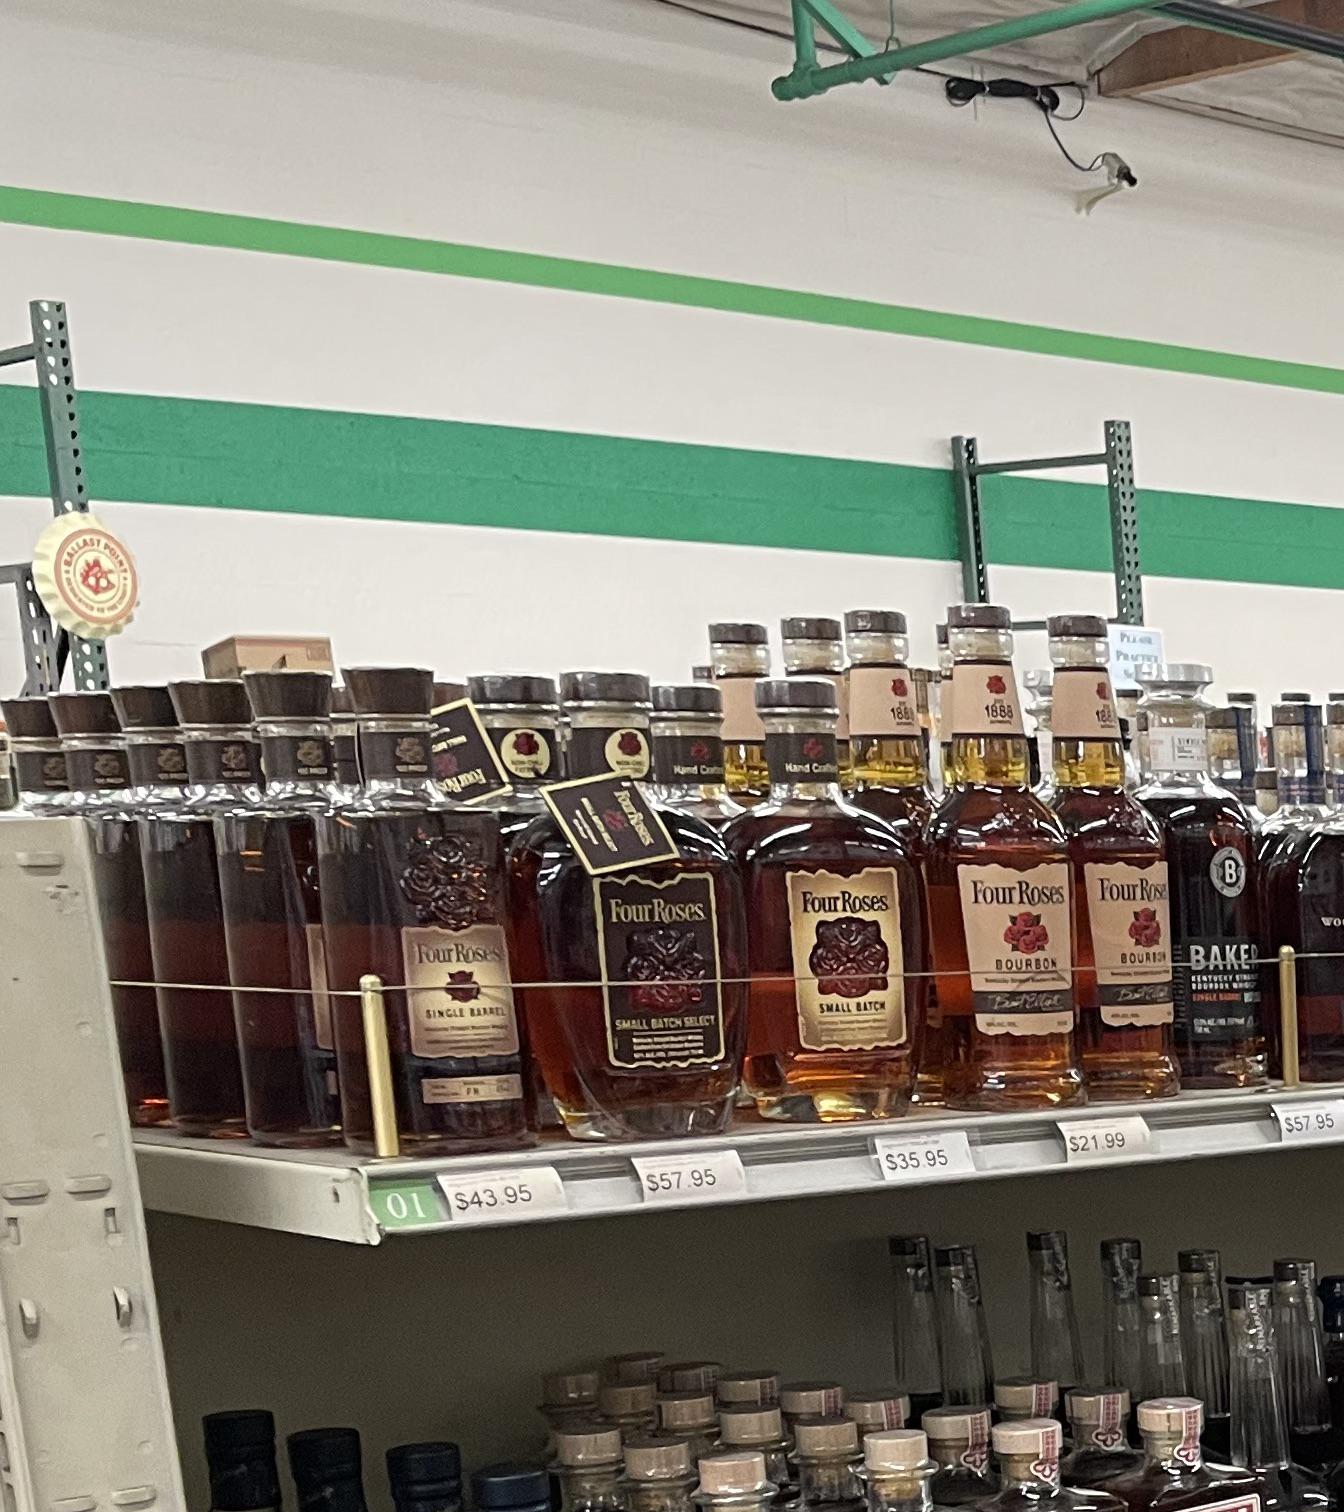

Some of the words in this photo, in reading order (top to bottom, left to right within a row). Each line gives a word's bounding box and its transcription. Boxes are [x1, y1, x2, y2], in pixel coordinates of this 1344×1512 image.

[63, 536, 102, 568] BALLAST
[103, 542, 128, 575] POINT
[971, 880, 1018, 905] Four
[1017, 880, 1065, 905] Roses
[1096, 877, 1141, 902] Four
[609, 899, 654, 924] Four
[652, 899, 706, 922] Roses
[801, 891, 843, 914] Four
[841, 890, 889, 912] Roses
[416, 943, 455, 965] Four
[452, 943, 503, 963] Roses
[995, 957, 1058, 971] BOURBON
[424, 1006, 467, 1020] SINGLE
[819, 1002, 853, 1015] SMALL
[855, 1000, 887, 1013] BATCH
[615, 1017, 649, 1031] SMALL
[650, 1016, 683, 1029] BATCH
[683, 1014, 716, 1028] SELECT
[1284, 1113, 1336, 1134] $57.95
[1068, 1132, 1127, 1153] $21.99
[884, 1148, 949, 1172] $35.95
[645, 1167, 718, 1193] $57.95
[385, 1191, 426, 1221] 01
[454, 1183, 533, 1212] $43.95
